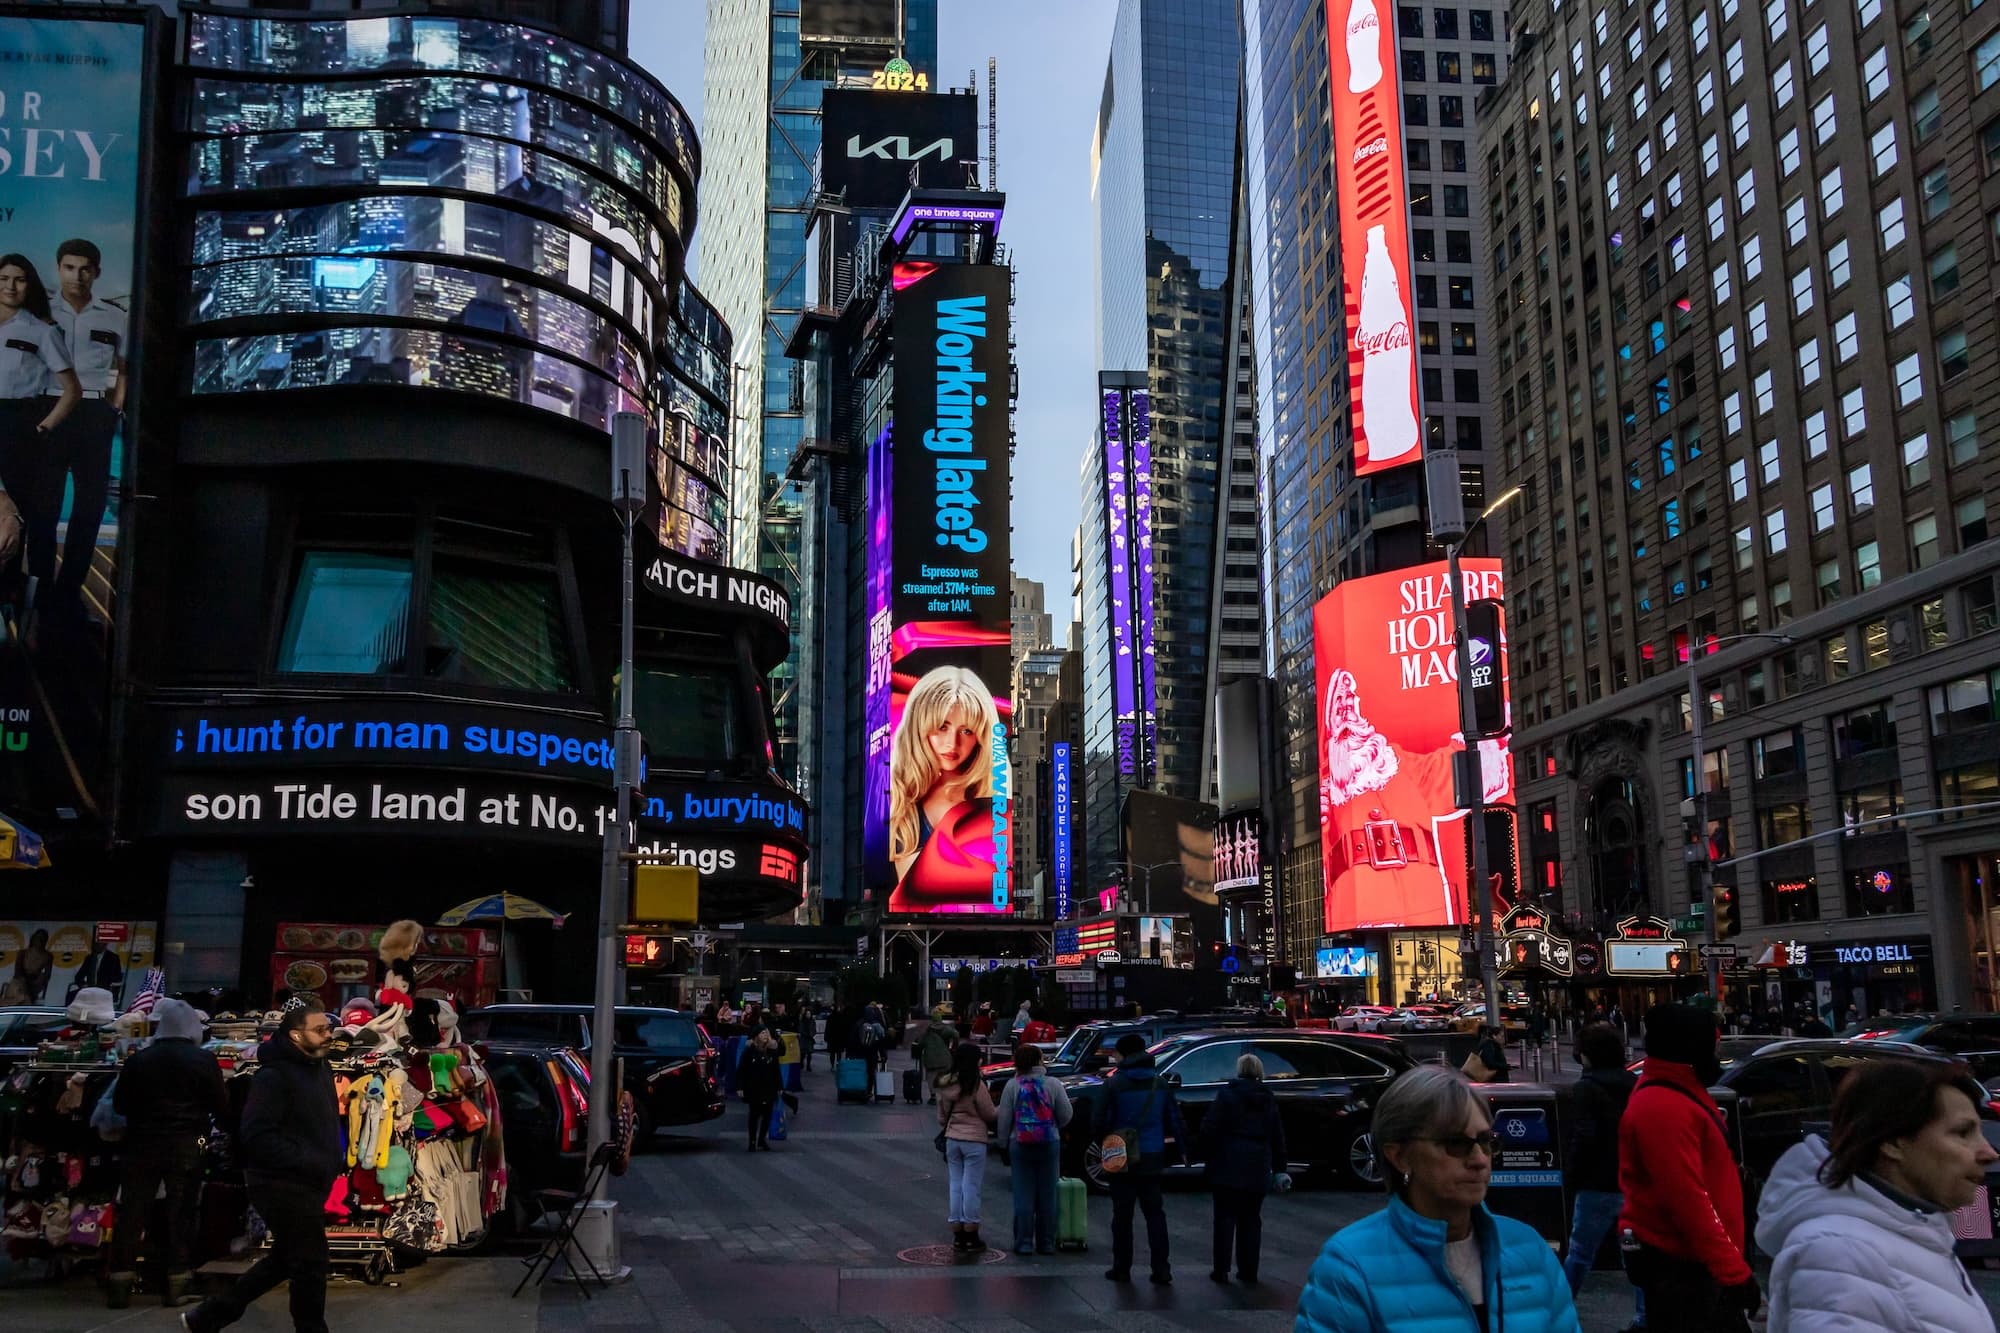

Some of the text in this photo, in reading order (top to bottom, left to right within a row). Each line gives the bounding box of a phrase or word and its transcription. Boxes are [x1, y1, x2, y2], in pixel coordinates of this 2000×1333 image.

[872, 71, 929, 91] 2024
[847, 134, 953, 162] KIA
[914, 208, 995, 220] one times square
[923, 296, 988, 553] Working late?
[646, 558, 719, 600] ATCH
[921, 564, 979, 580] Espresso was
[902, 582, 996, 596] streamed 37M+ times
[927, 599, 973, 613] after 1AM.
[1472, 676, 1493, 689] ELL
[8, 708, 31, 723] ON
[196, 719, 284, 753] hunt
[292, 716, 344, 750] for
[354, 721, 449, 750] man
[185, 792, 262, 820] son
[274, 784, 358, 820] Tide
[370, 784, 465, 822] land
[478, 793, 520, 826] at
[531, 794, 585, 834] No.
[1057, 763, 1067, 836] FANDUEL
[684, 792, 785, 829] burying
[992, 762, 1009, 912] WRAPPED
[1263, 865, 1275, 966] TIMES SQUARE
[1686, 921, 1696, 929] 44
[1835, 944, 1913, 963] TACO BELL
[1231, 976, 1261, 984] CHASE
[1490, 1174, 1560, 1184] IMES SQUARE
